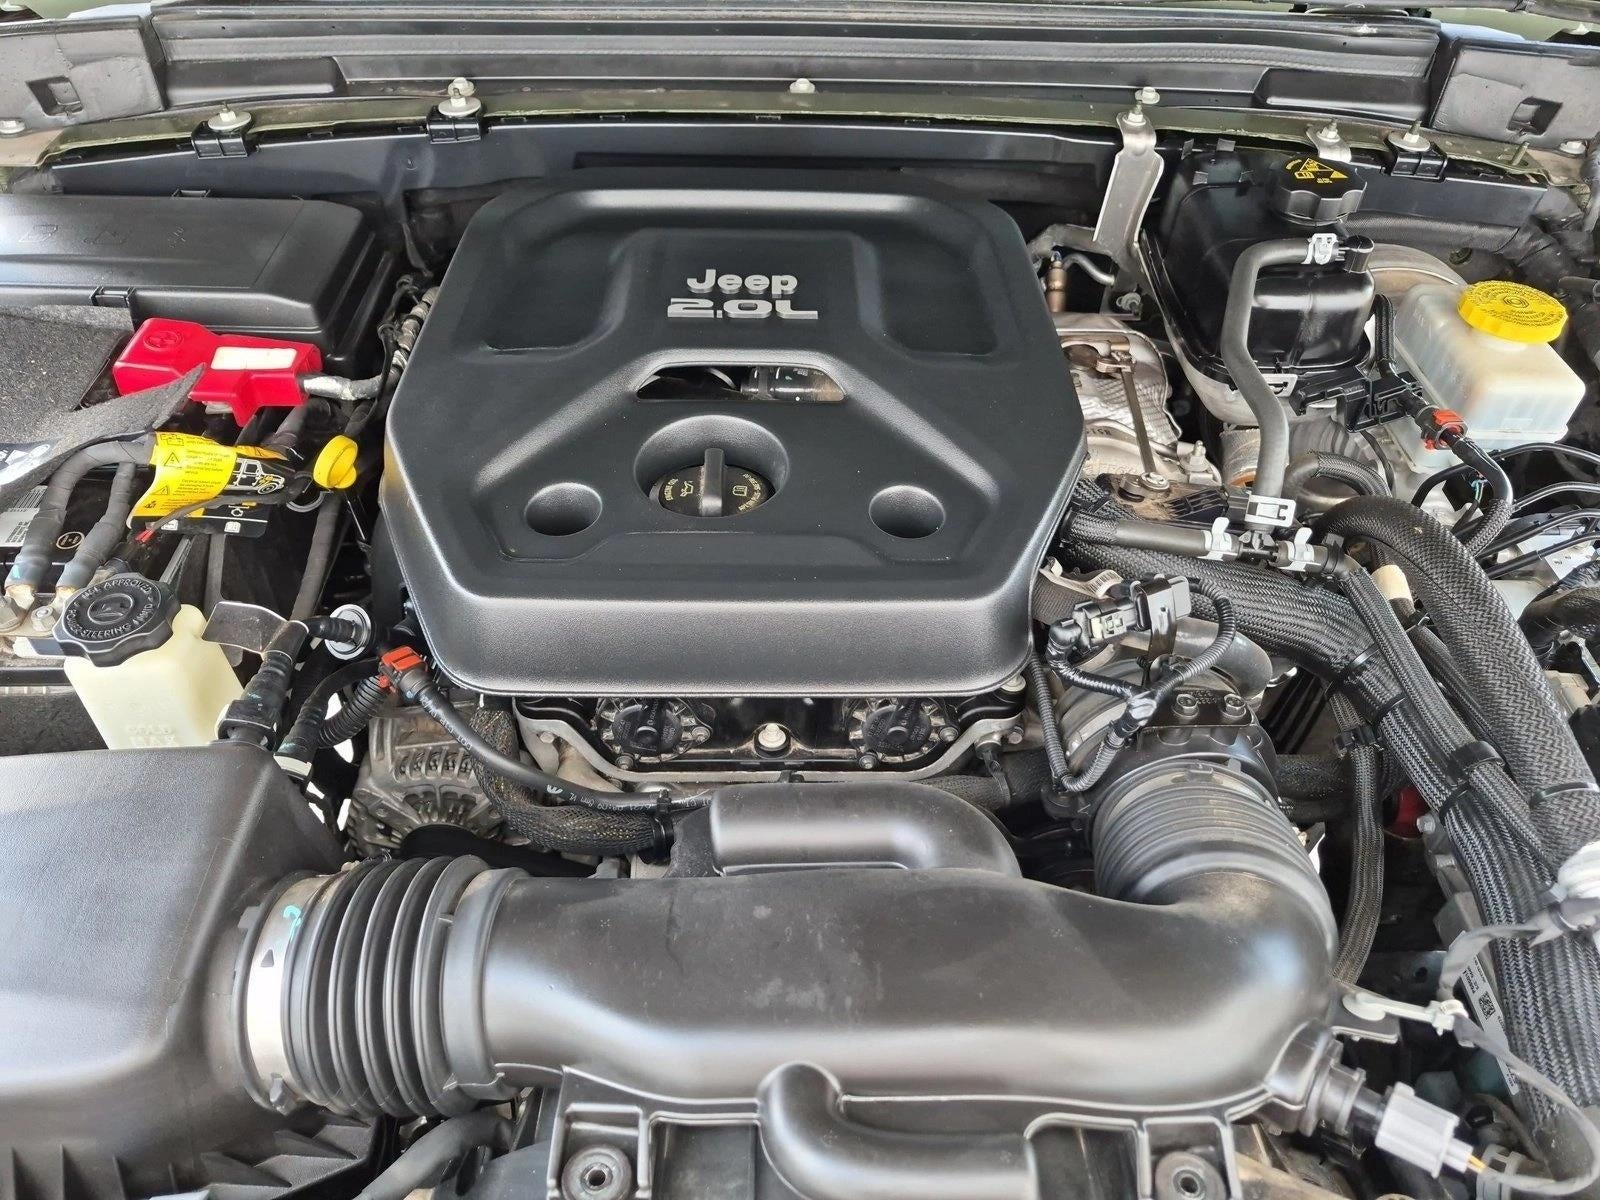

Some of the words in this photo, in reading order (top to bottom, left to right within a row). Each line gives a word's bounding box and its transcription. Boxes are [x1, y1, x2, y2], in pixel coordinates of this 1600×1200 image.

[686, 268, 798, 298] Jeep
[667, 297, 819, 320] 2.0L
[103, 578, 153, 596] APPROVED
[80, 621, 132, 640] STEERING
